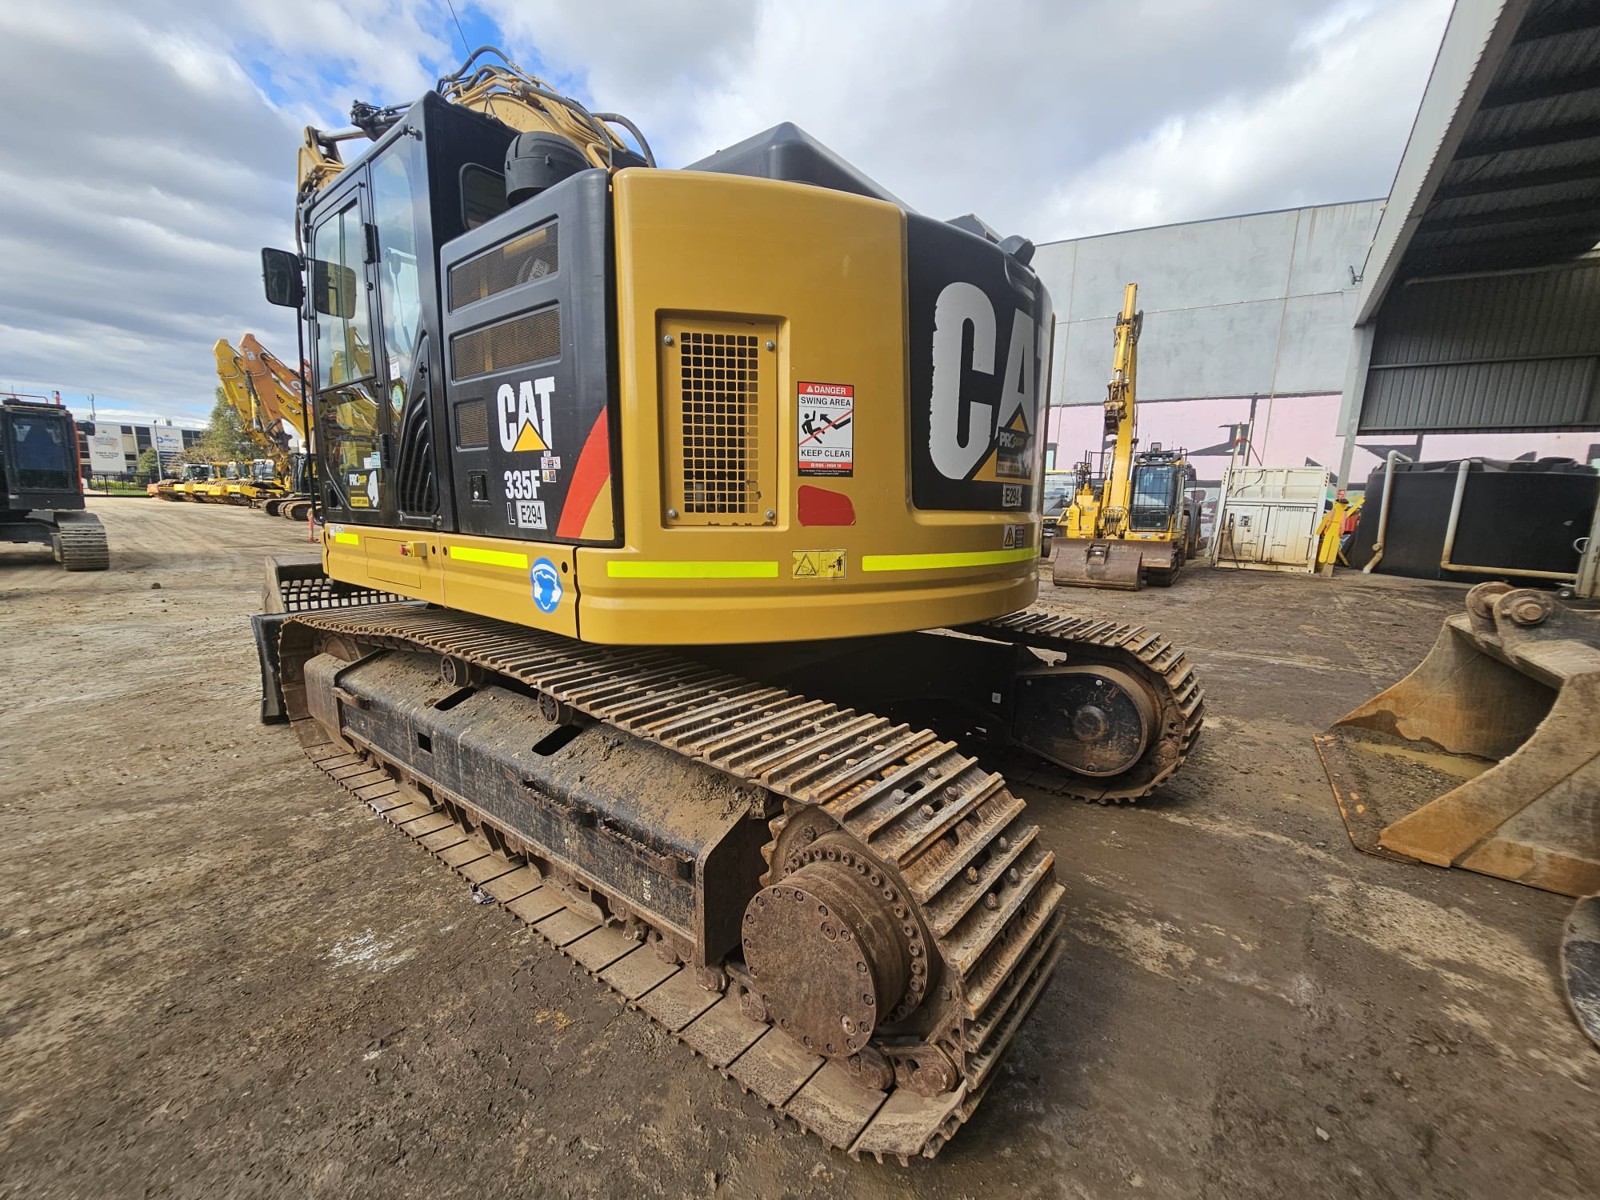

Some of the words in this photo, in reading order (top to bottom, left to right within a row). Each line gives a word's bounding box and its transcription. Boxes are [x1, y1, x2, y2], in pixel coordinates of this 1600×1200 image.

[814, 385, 846, 395] DANGER
[800, 396, 828, 405] SWING
[829, 398, 851, 407] AREA
[497, 376, 555, 452] CAT
[800, 449, 823, 457] KEEP
[824, 449, 851, 458] CLEAR
[503, 470, 541, 499] 335F
[506, 502, 516, 526] L
[520, 505, 542, 525] E294
